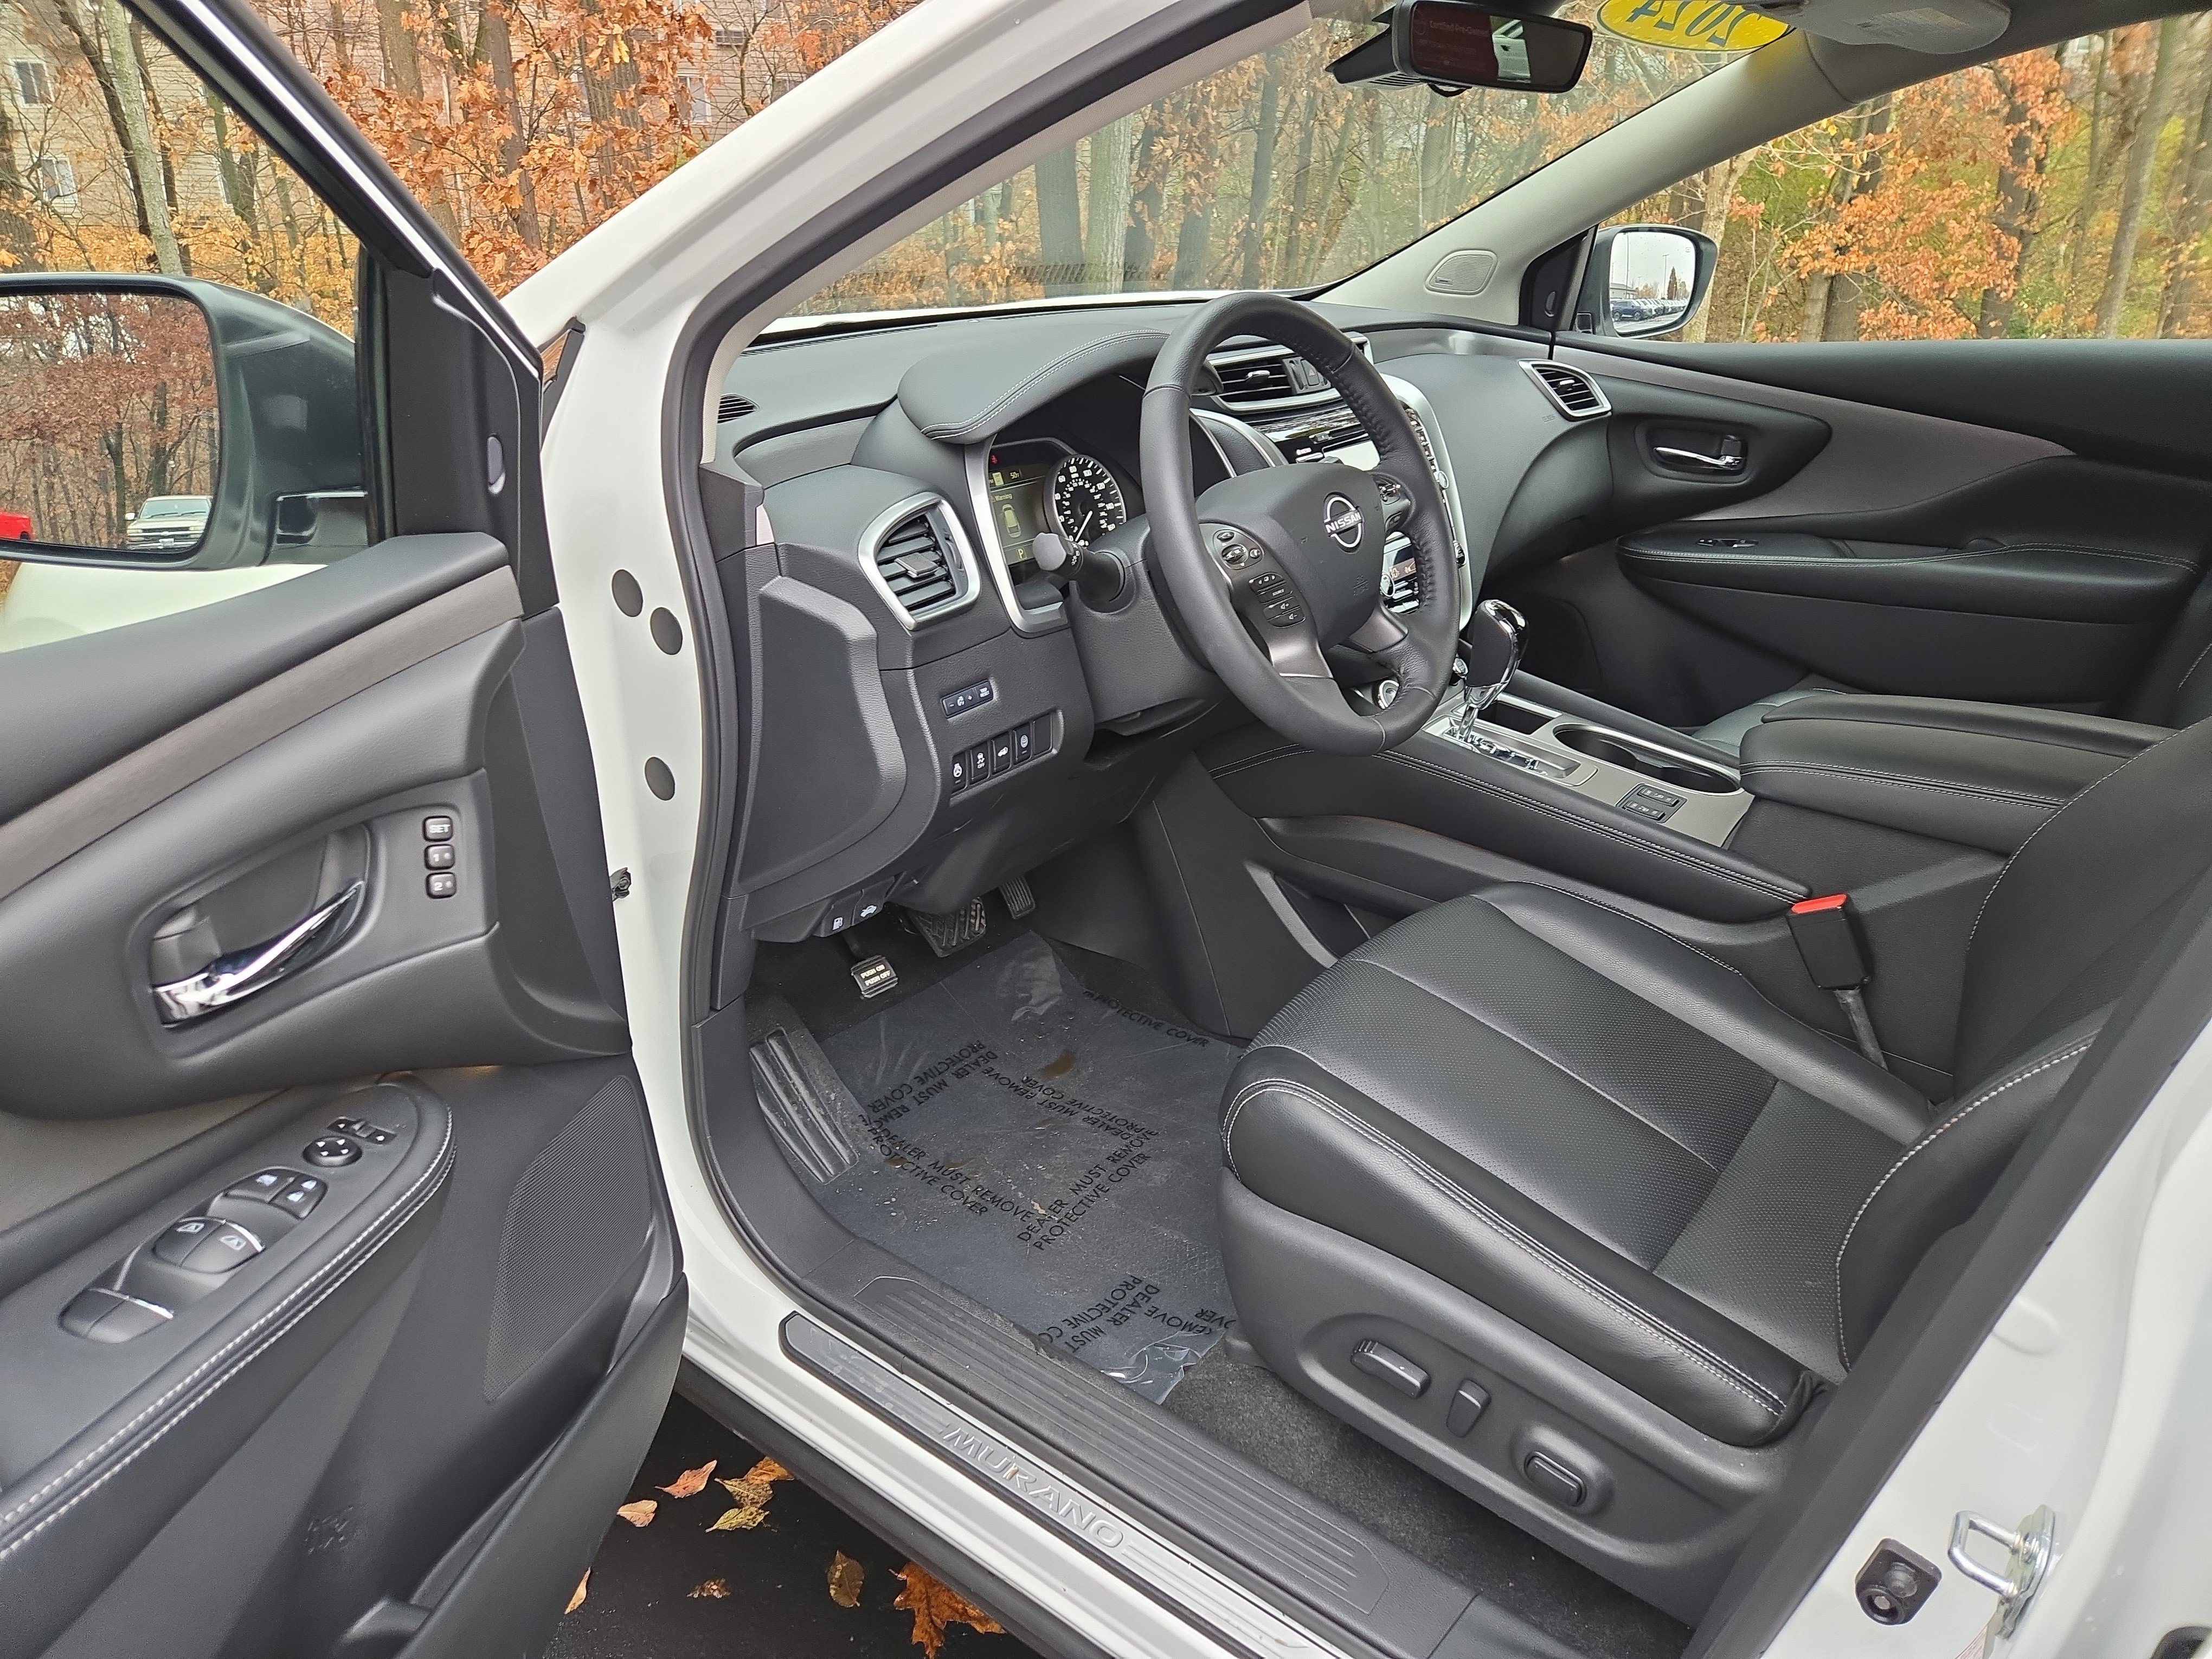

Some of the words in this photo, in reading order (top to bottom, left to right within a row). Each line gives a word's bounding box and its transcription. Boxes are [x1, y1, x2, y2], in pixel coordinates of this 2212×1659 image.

[1325, 512, 1362, 533] NISSAN
[1018, 548, 1024, 559] P
[429, 824, 451, 833] SET
[433, 853, 440, 861] 1
[434, 882, 443, 891] 2
[860, 968, 877, 979] PUSH
[864, 975, 881, 986] PUSH
[879, 970, 891, 979] OFF
[1166, 1028, 1208, 1047] COVER
[914, 1039, 986, 1085] PROTECTIVE
[951, 1051, 998, 1079] DEALER
[913, 1078, 949, 1105] MUST
[982, 1066, 1038, 1100] REMOVE
[1021, 1075, 1064, 1100] COVER
[867, 1083, 912, 1113] COVER
[1036, 1098, 1078, 1117] MUST
[1066, 1098, 1146, 1134] PROTECTIVE
[1082, 1115, 1131, 1140] DEALER
[867, 1128, 940, 1186] PROTCTIVE
[941, 1184, 988, 1217] COVER
[880, 1128, 927, 1160] DEALER
[928, 1160, 971, 1185] MUST
[971, 1184, 1035, 1223] REMOVE
[1069, 1163, 1107, 1195] MUST
[1105, 1130, 1159, 1163] REMOVE
[1033, 1183, 1110, 1251] PROTECTIVE
[1108, 1153, 1152, 1182] COVER
[1062, 1275, 1143, 1330] PROTECTIVE
[1107, 1284, 1161, 1327] DEALER
[1064, 1325, 1107, 1353] MUST
[943, 1427, 1124, 1548] MURANO
